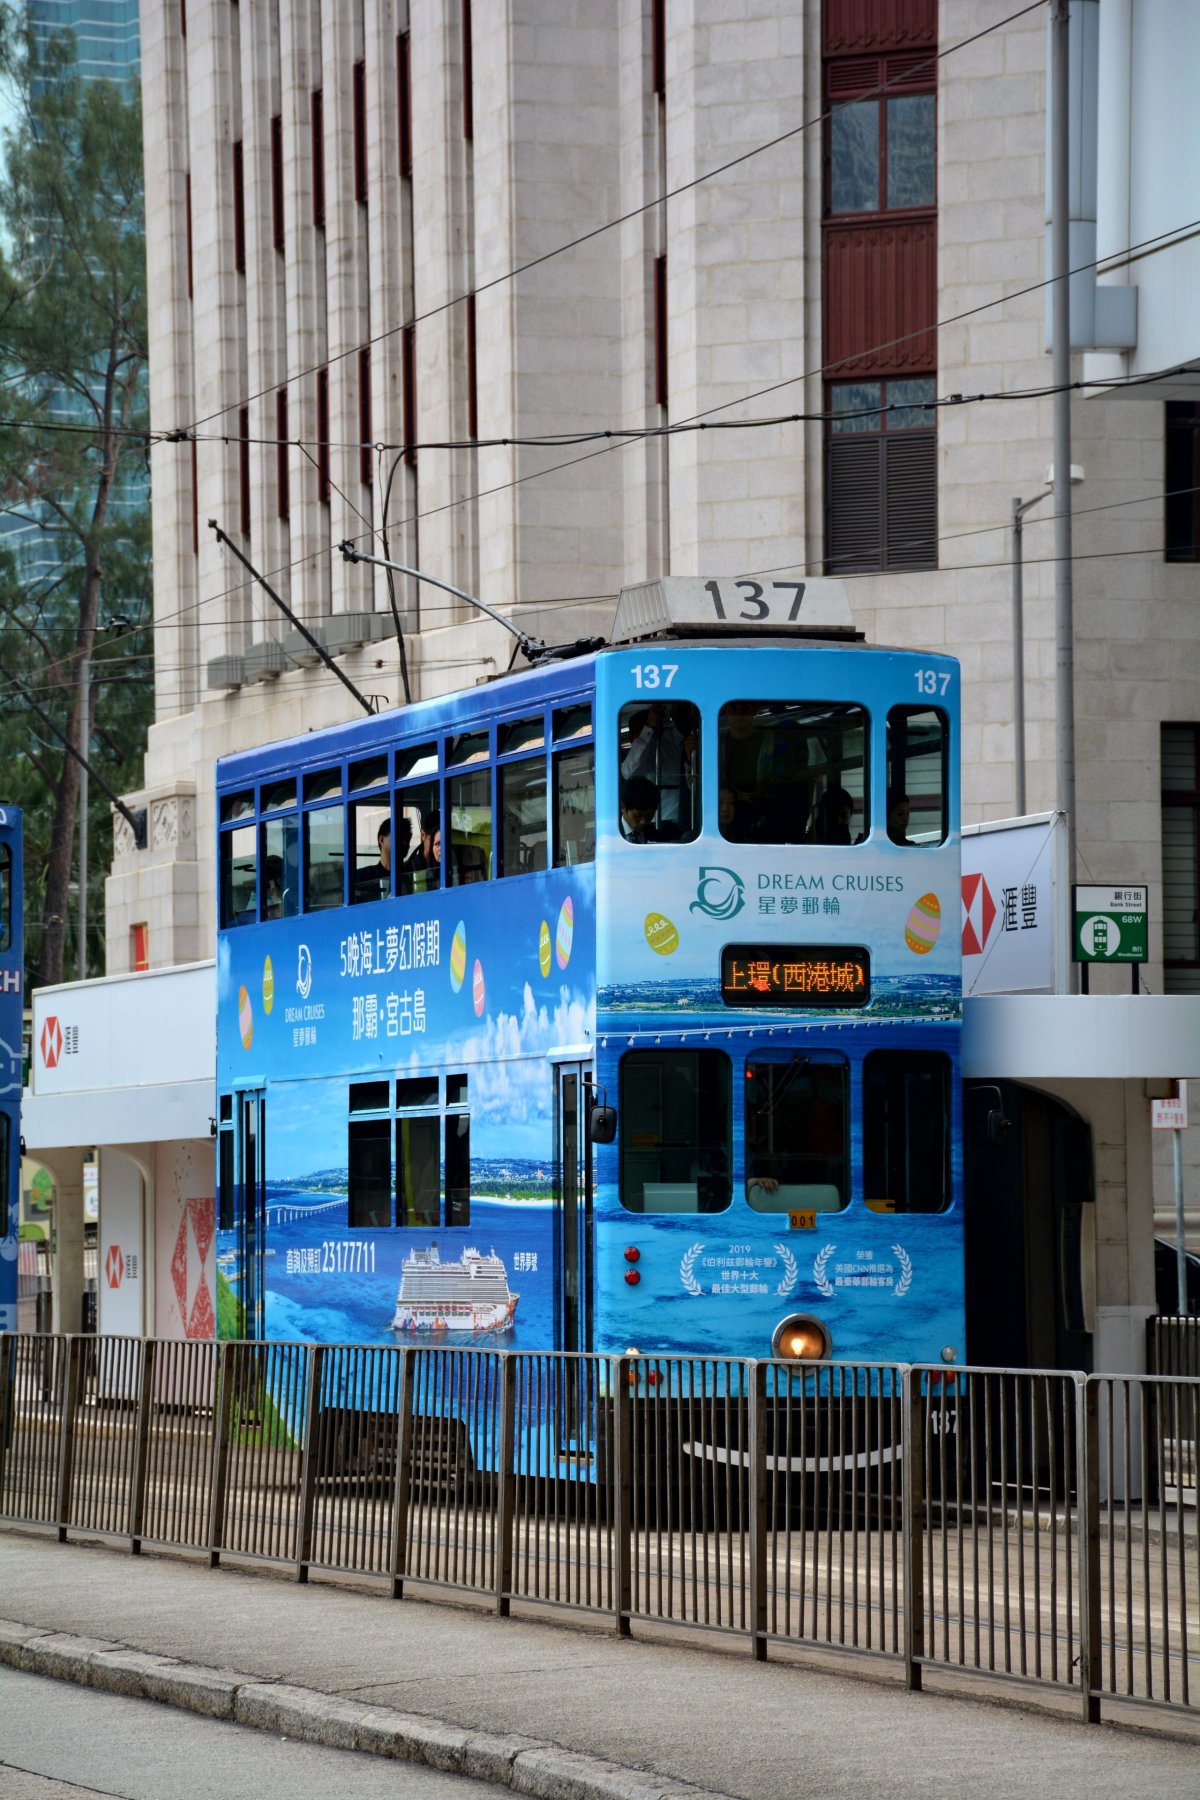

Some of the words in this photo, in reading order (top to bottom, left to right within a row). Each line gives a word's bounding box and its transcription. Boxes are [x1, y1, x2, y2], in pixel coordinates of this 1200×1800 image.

[704, 580, 806, 621] 137
[630, 664, 679, 689] 137
[914, 669, 951, 696] 137
[757, 873, 825, 890] DREAM
[831, 874, 904, 892] CRUISES
[757, 896, 841, 915] 星夢郵輪
[1114, 891, 1142, 901] 銀行街
[1121, 915, 1143, 924] 68W
[340, 920, 440, 977] 5晚海上夢幻假期
[285, 1007, 303, 1023] DREAM
[304, 1004, 325, 1021] CRUISES
[791, 1215, 814, 1227] 001
[322, 1241, 375, 1273] 23177711
[729, 1245, 751, 1254] 2019
[721, 1270, 759, 1281] 世界十大
[931, 1410, 959, 1435] 137
